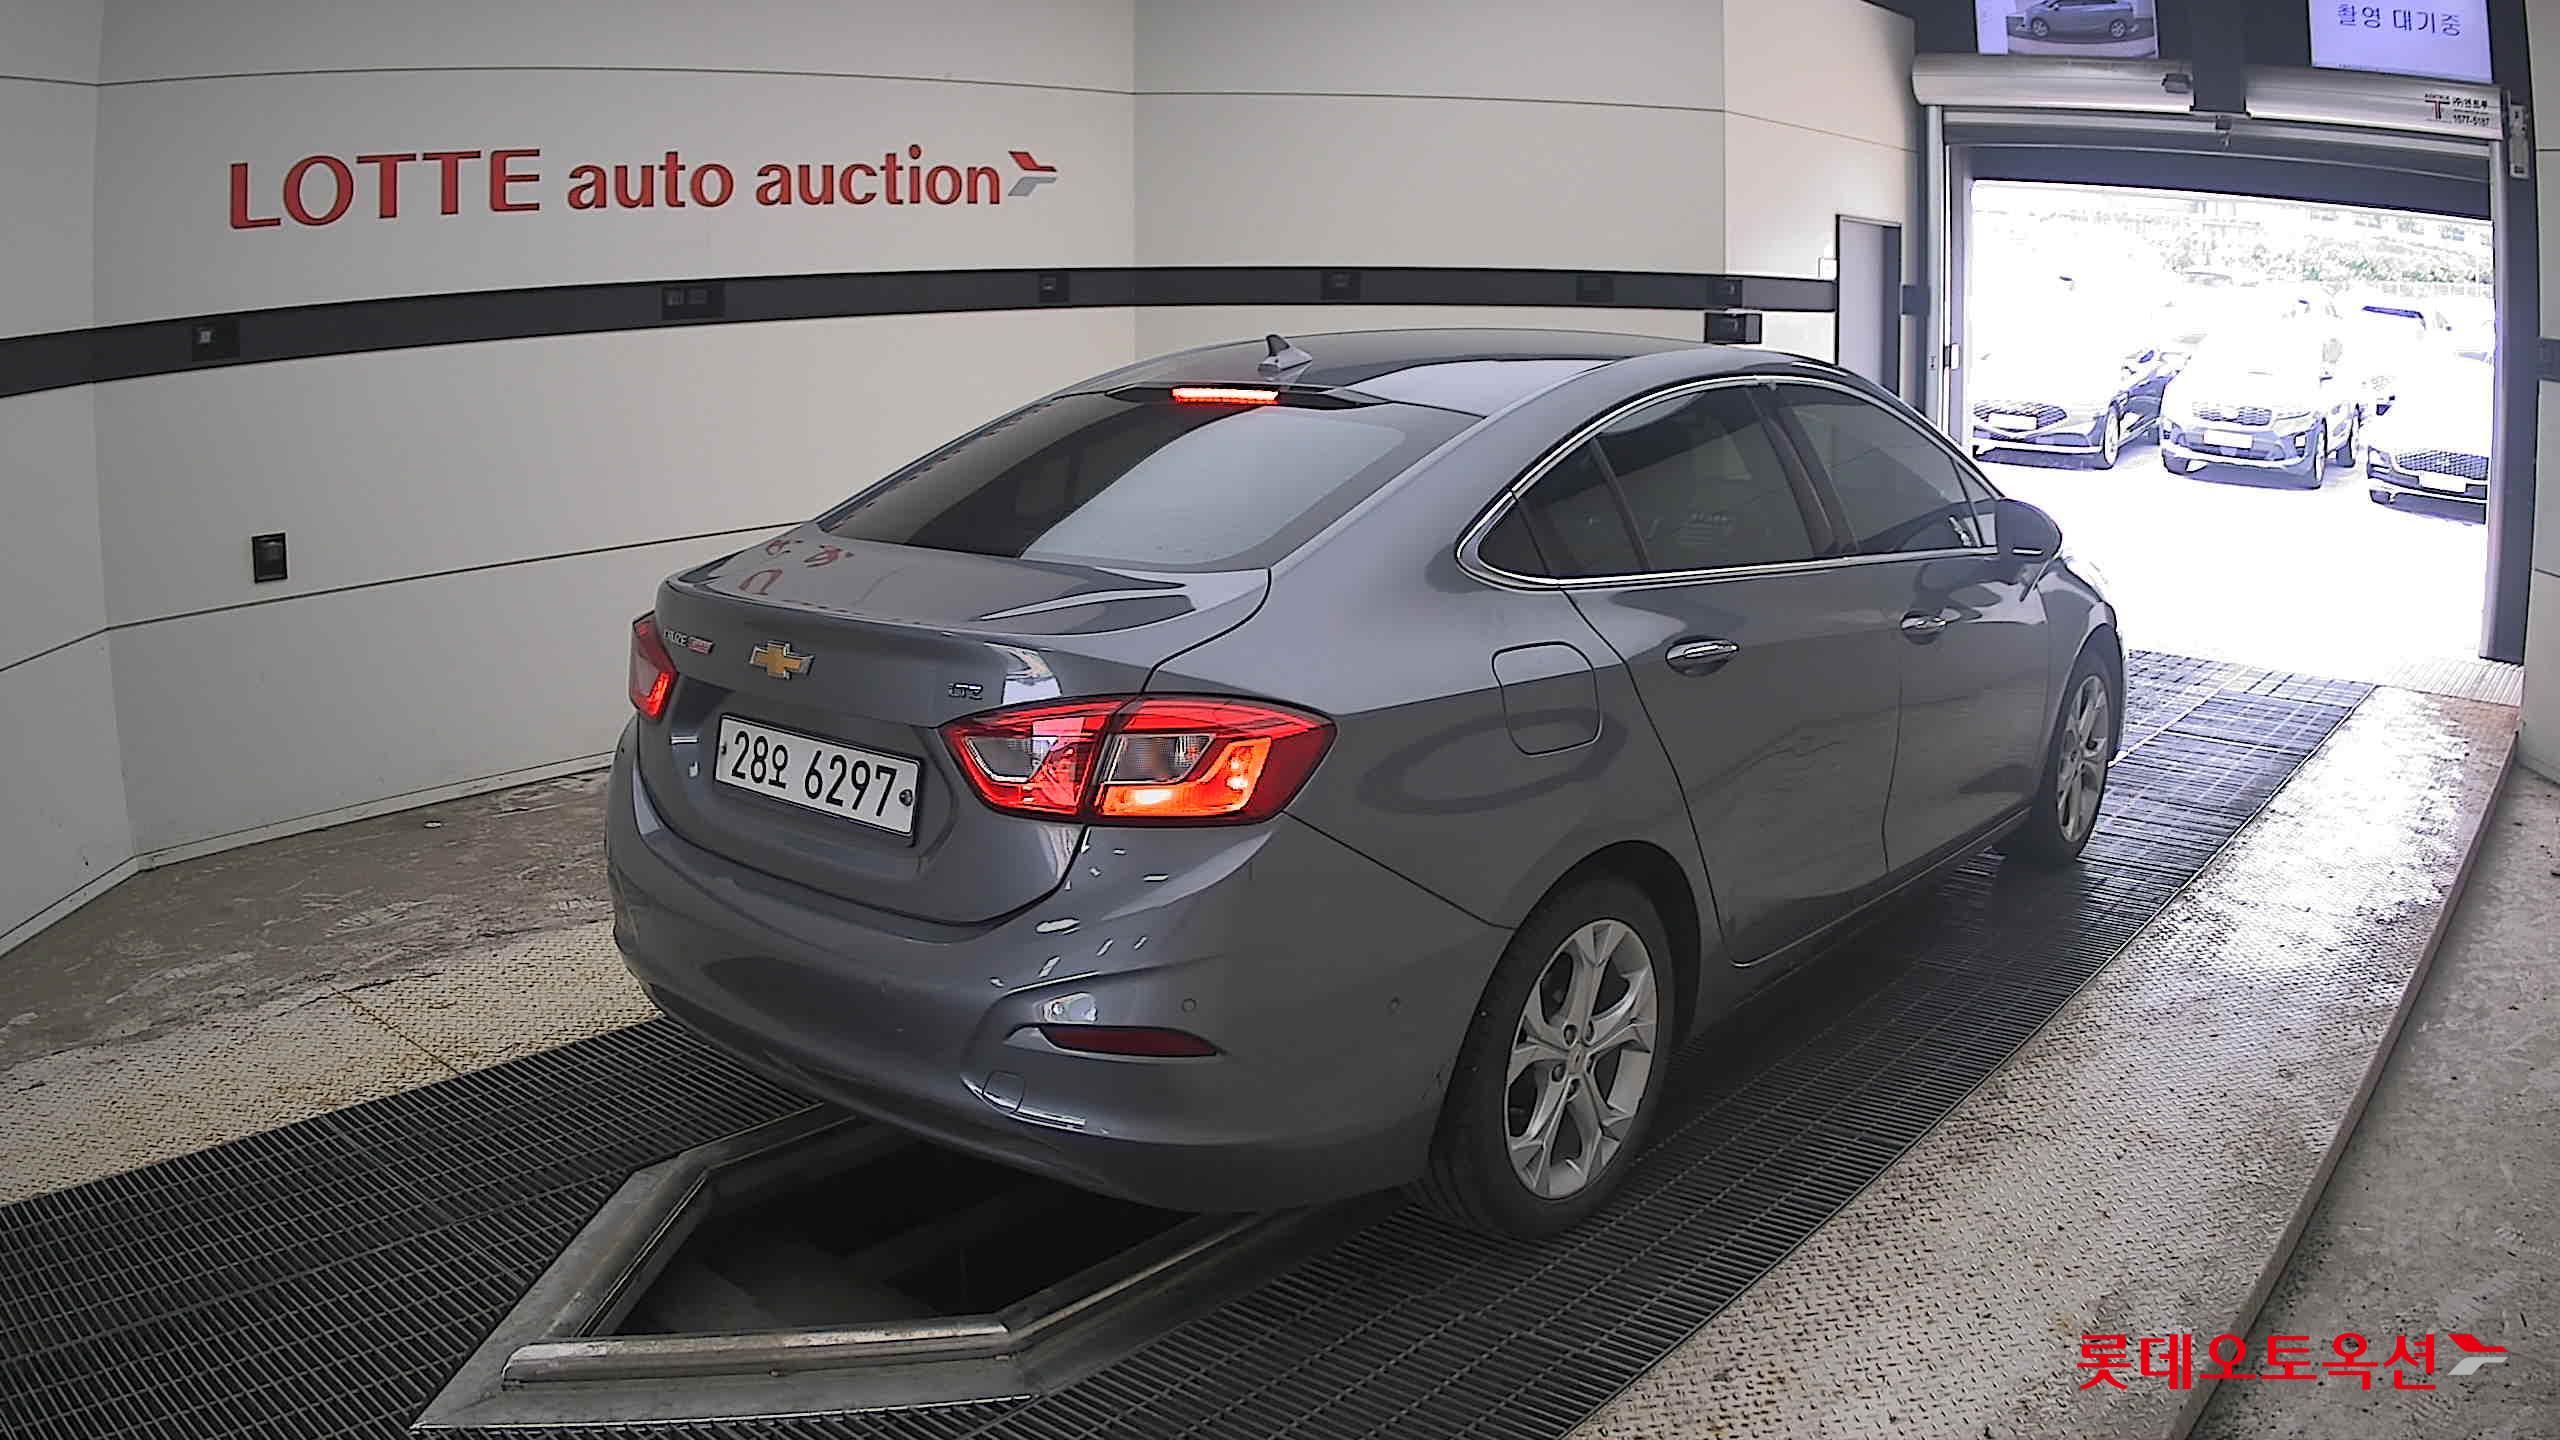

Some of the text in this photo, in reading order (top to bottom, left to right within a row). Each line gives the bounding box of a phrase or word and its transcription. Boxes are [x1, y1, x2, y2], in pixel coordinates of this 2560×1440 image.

[2337, 4, 2461, 37] 촬영 대기중
[229, 144, 1002, 230] LOTTE auto auction
[731, 730, 897, 817] 28오 6297
